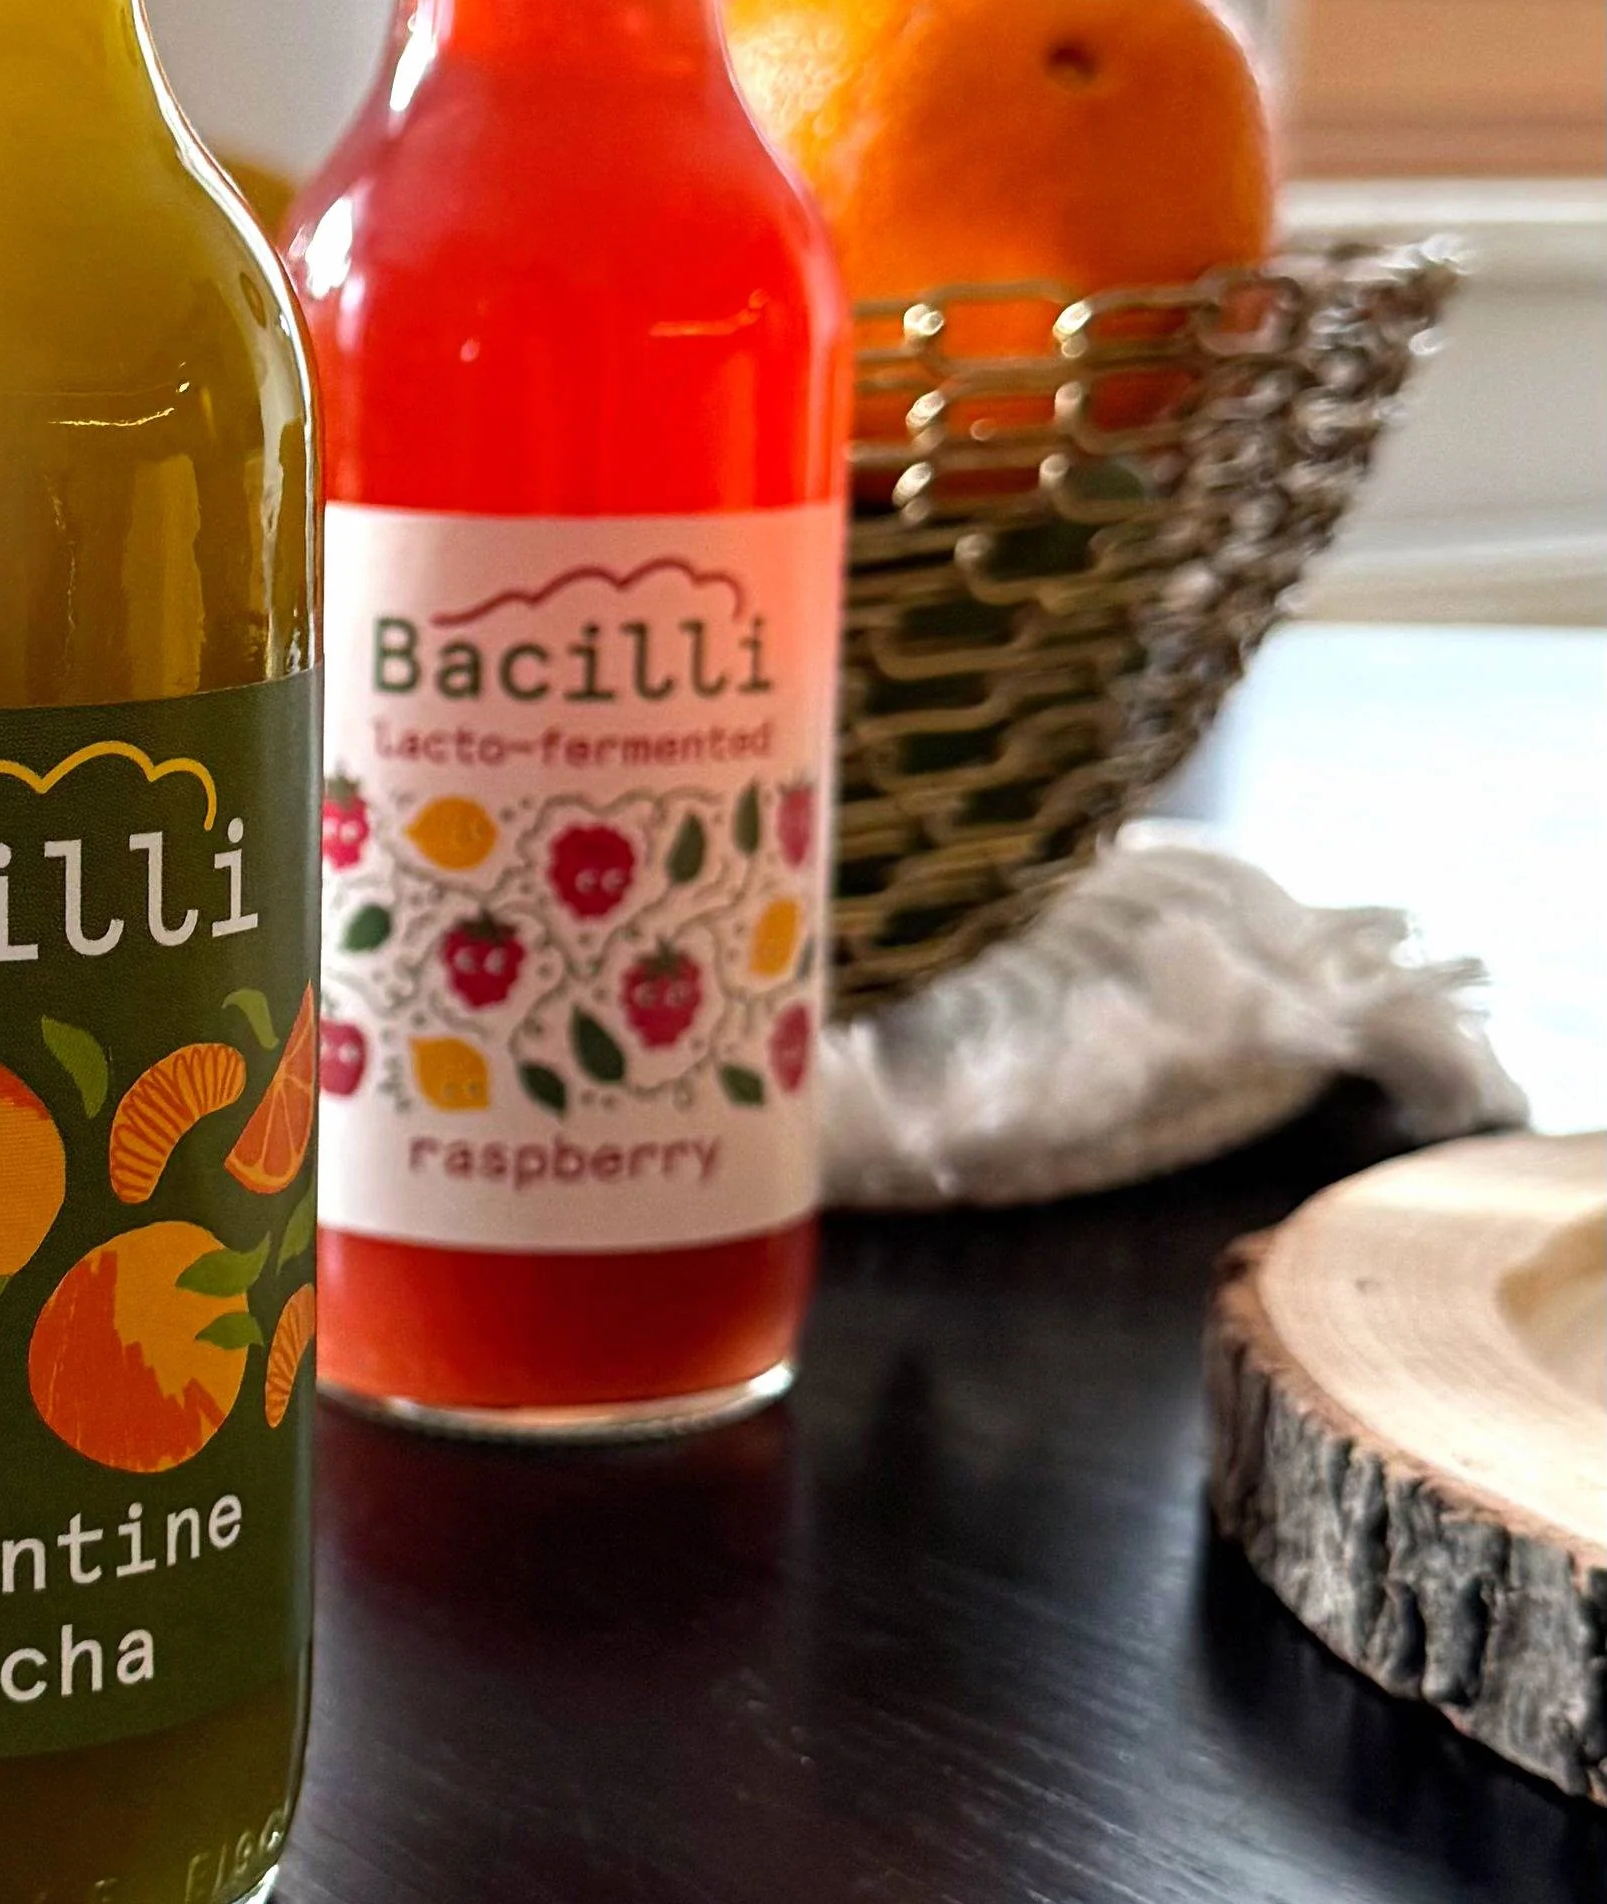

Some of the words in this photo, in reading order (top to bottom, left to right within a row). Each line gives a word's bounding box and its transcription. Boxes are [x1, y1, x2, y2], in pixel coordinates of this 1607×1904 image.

[372, 616, 774, 702] Bacilli
[372, 714, 775, 767] lacto-fermented
[408, 1132, 722, 1192] raspberry
